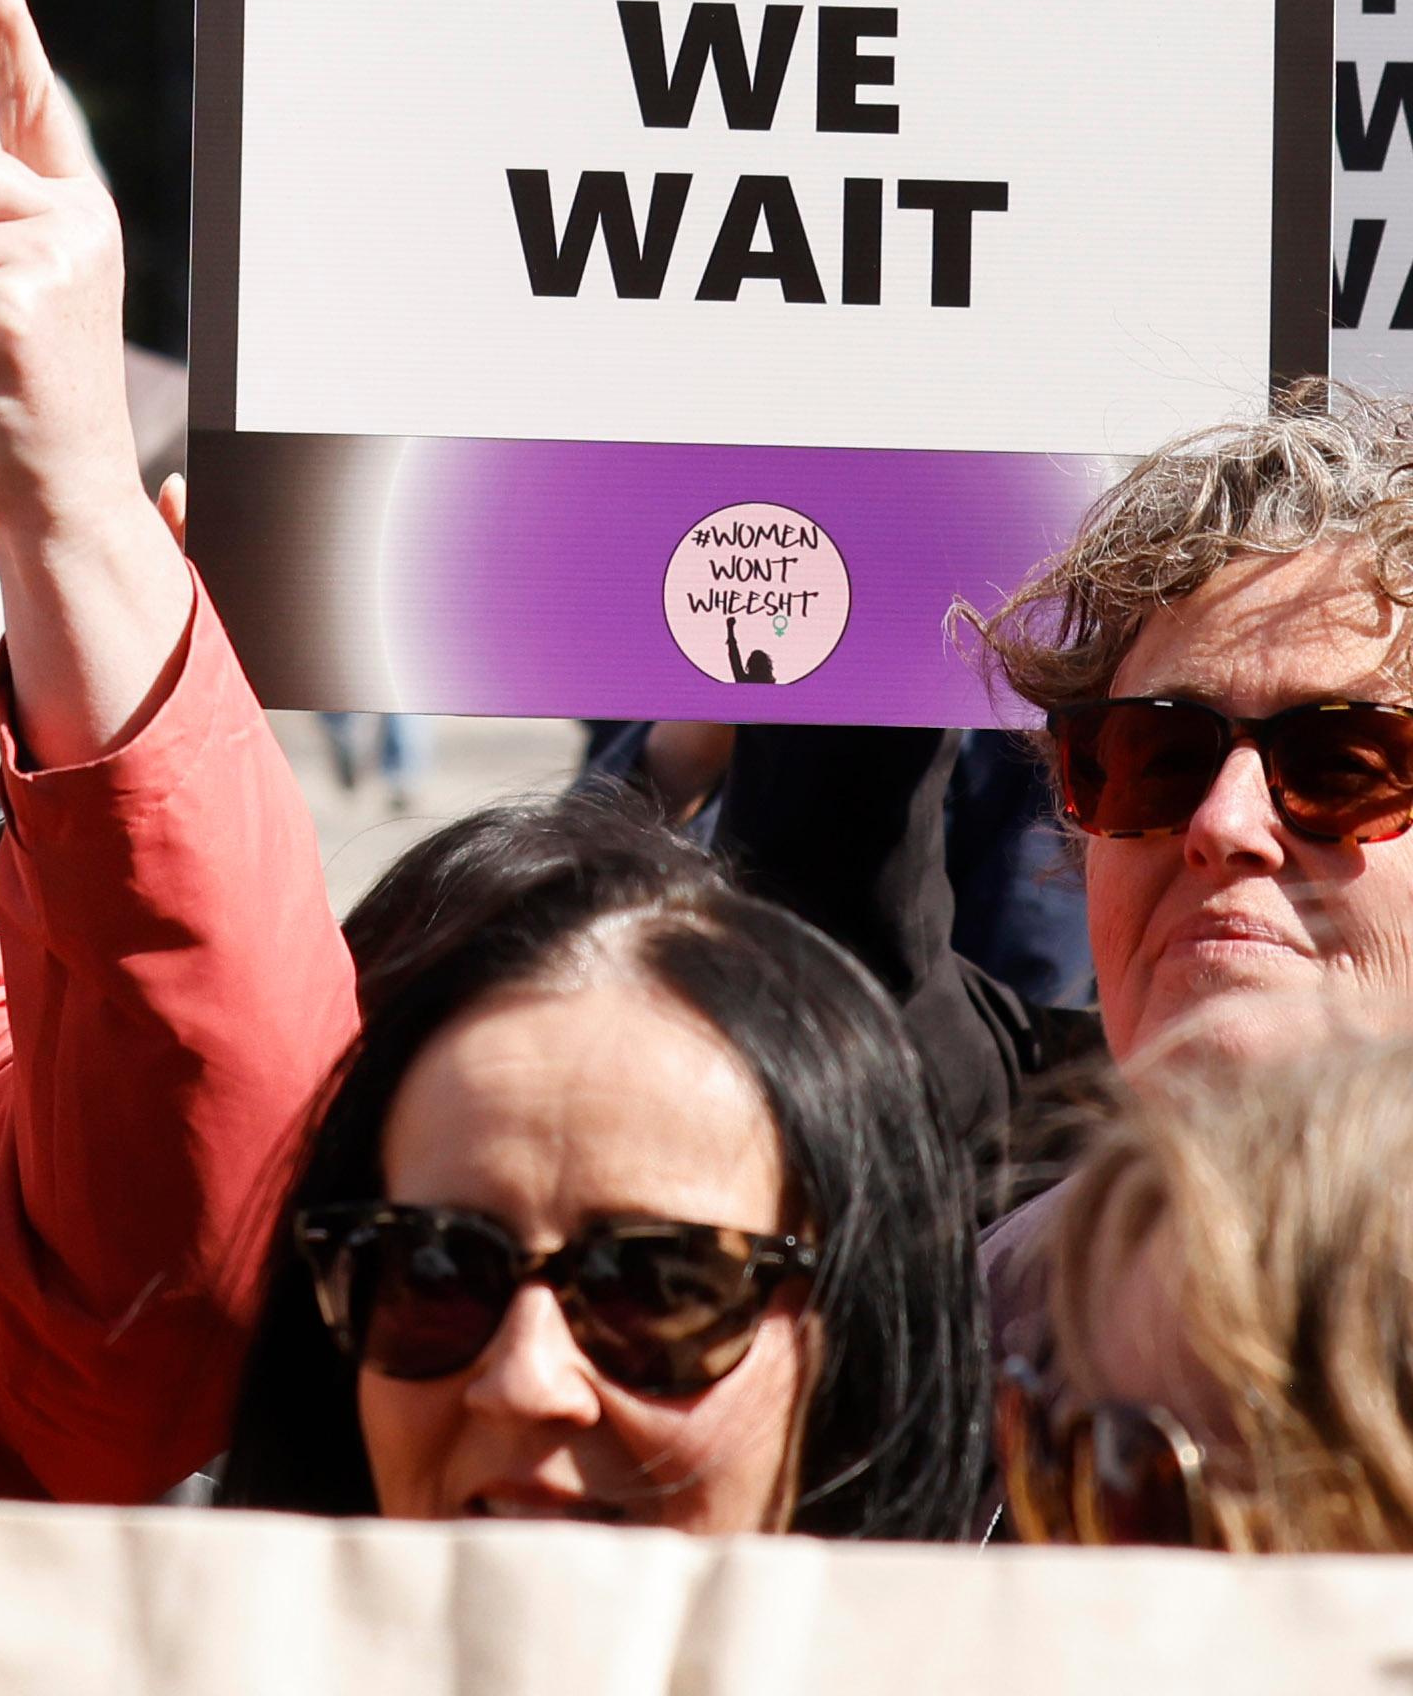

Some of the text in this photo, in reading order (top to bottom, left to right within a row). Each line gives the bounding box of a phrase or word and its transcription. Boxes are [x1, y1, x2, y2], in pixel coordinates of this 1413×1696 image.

[617, 1, 899, 133] WE
[507, 169, 1008, 307] WAIT
[691, 521, 818, 550] #WOMEN
[709, 555, 799, 583] WONT
[687, 588, 819, 617] WHEESHT
